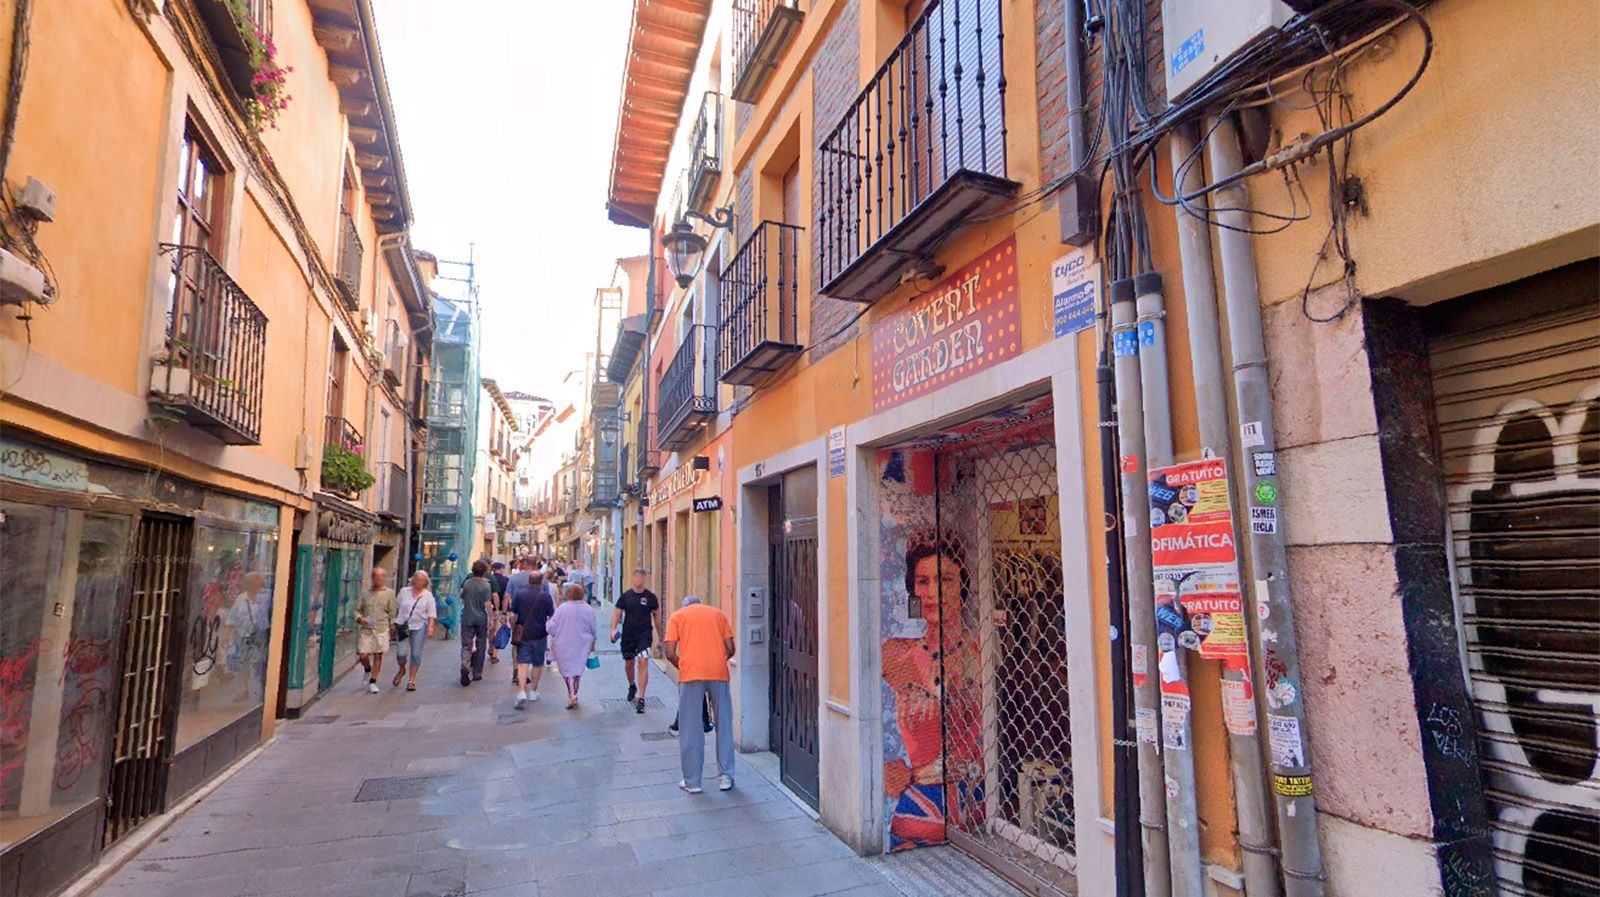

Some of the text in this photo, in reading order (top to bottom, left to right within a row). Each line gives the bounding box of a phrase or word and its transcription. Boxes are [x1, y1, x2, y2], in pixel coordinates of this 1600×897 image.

[1054, 255, 1085, 279] tyco
[1055, 291, 1084, 308] Alarma
[893, 274, 980, 354] COVENT
[893, 319, 984, 393] GARDEN
[1166, 467, 1224, 483] GRATUITO
[1149, 484, 1176, 501] WEB
[695, 500, 718, 510] ATM
[1152, 531, 1234, 552] OFIMÁTICA
[1157, 607, 1184, 629] WEB
